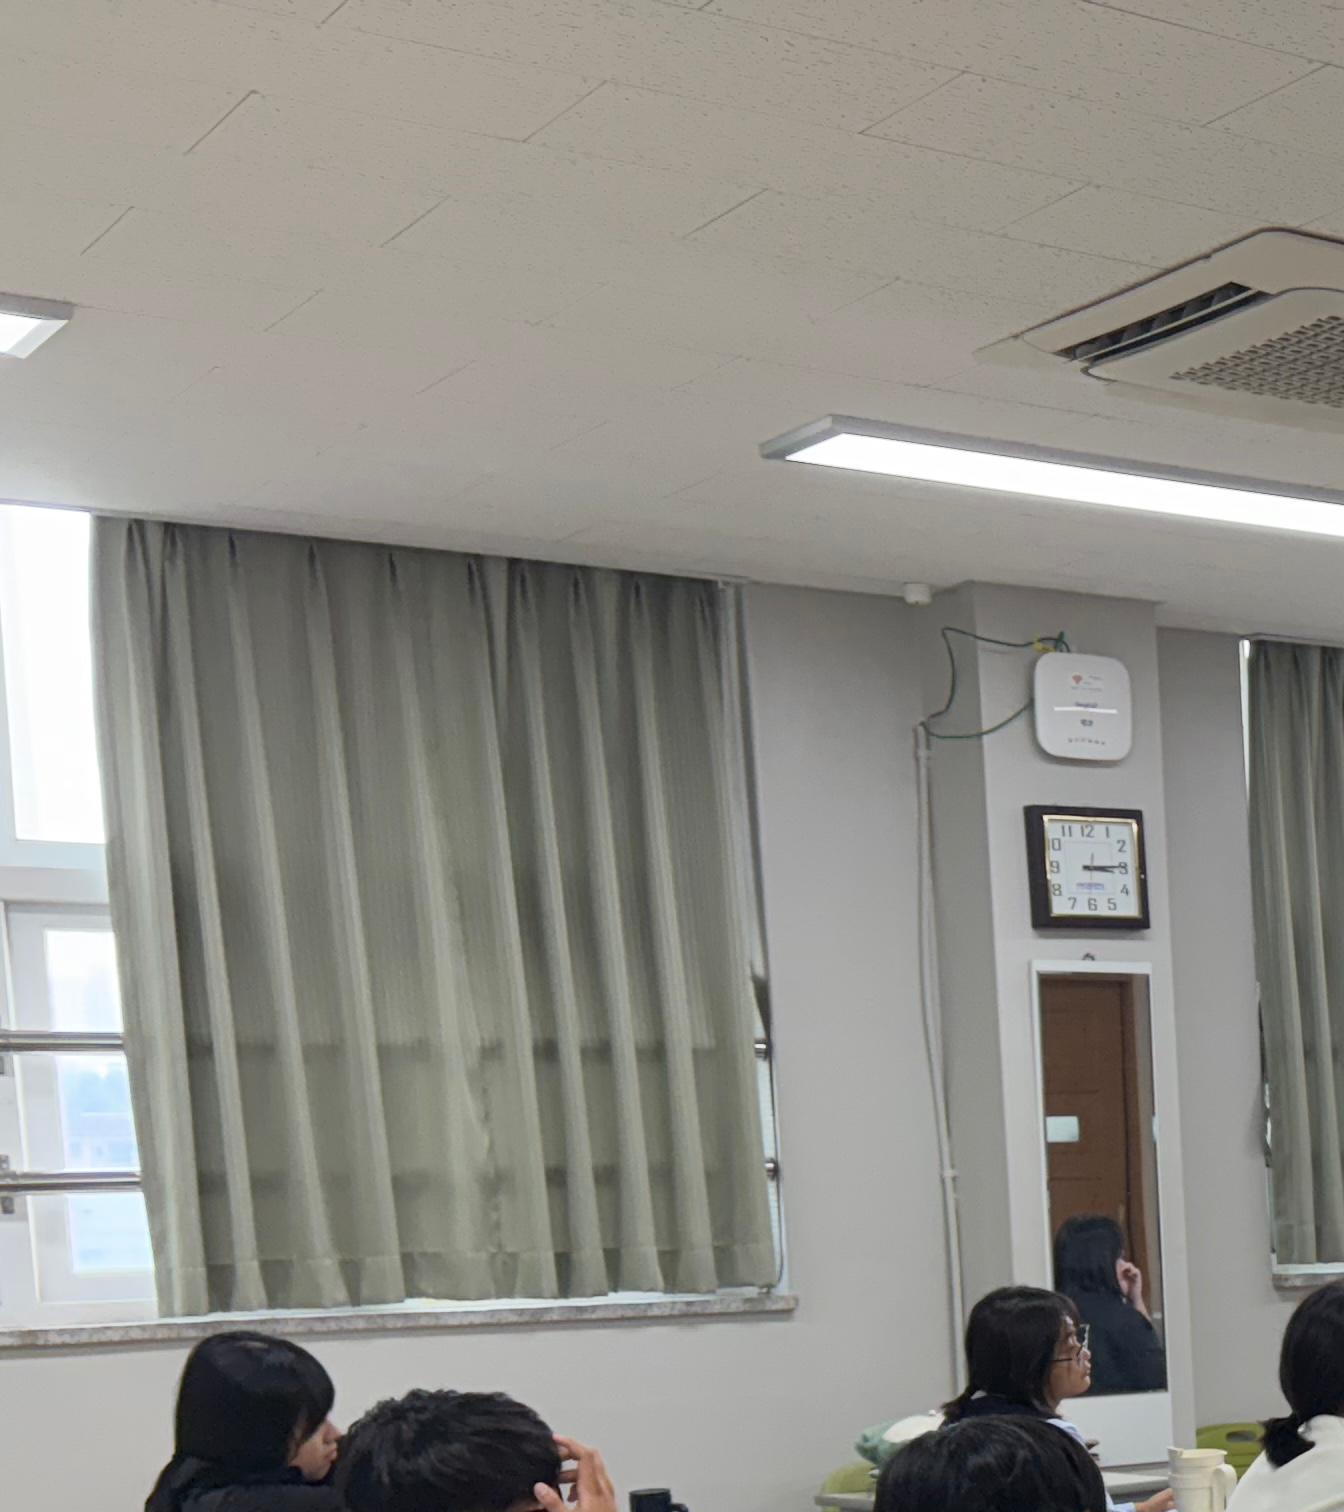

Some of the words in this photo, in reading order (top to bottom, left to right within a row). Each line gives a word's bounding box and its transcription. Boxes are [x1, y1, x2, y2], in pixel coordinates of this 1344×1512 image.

[1061, 825, 1072, 838] 11
[1081, 824, 1095, 838] 12
[1105, 826, 1110, 839] 1
[1116, 839, 1127, 853] 2
[1050, 860, 1060, 874] 9
[1052, 883, 1062, 897] 8
[1120, 884, 1129, 897] 4
[1067, 897, 1077, 911] 7
[1087, 898, 1098, 912] 6
[1107, 898, 1117, 911] 5
